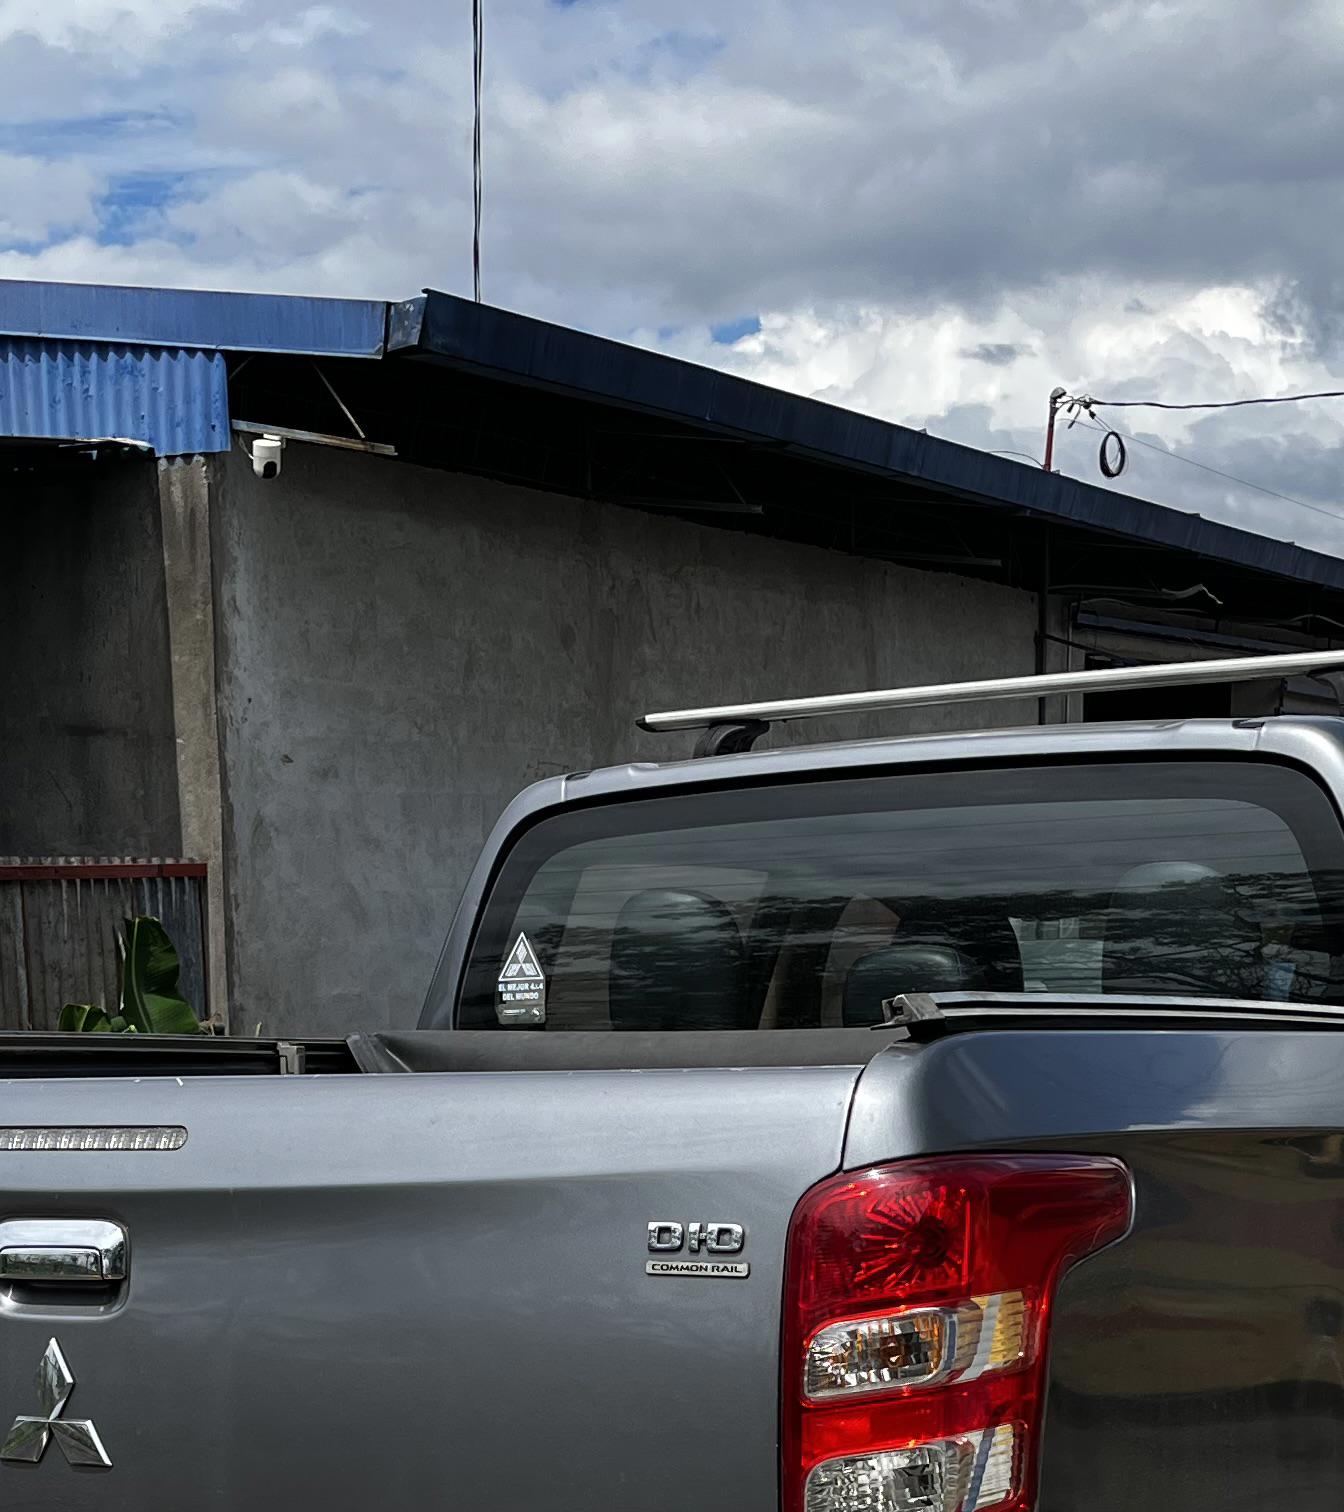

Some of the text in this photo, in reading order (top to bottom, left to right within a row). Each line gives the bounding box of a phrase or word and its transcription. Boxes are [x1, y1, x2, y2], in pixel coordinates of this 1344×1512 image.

[498, 983, 507, 992] EL
[502, 992, 539, 1001] DEL MUNDO
[651, 1263, 743, 1274] COMMON RAIL
